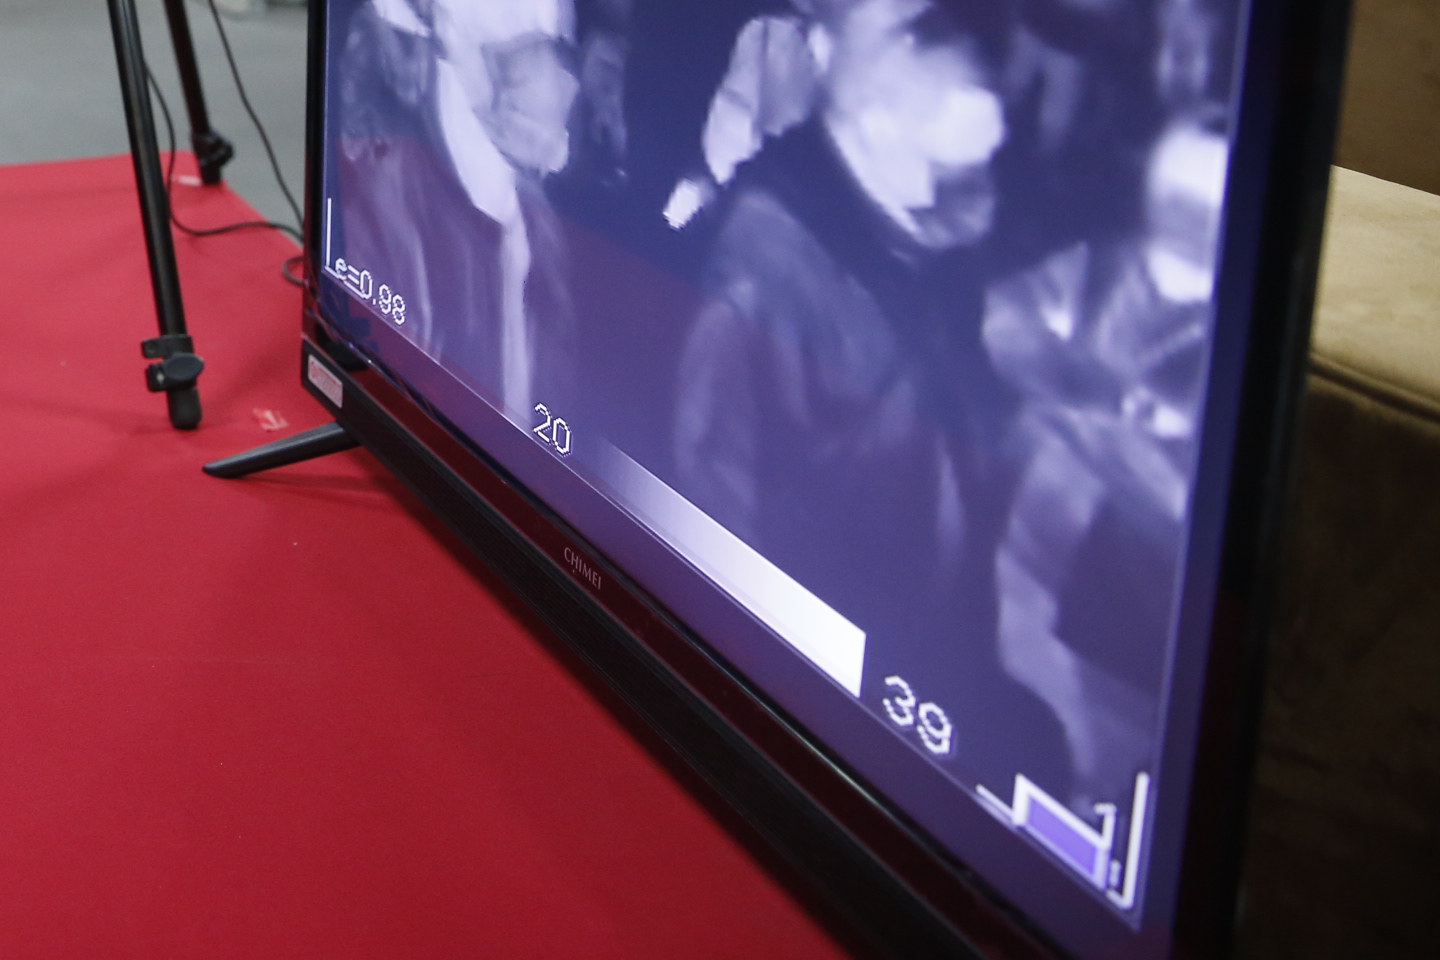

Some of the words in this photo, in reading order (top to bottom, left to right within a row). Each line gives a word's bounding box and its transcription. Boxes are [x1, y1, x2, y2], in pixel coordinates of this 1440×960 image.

[534, 402, 571, 454] 20
[563, 546, 602, 590] CHIMEI
[882, 674, 952, 754] 39
